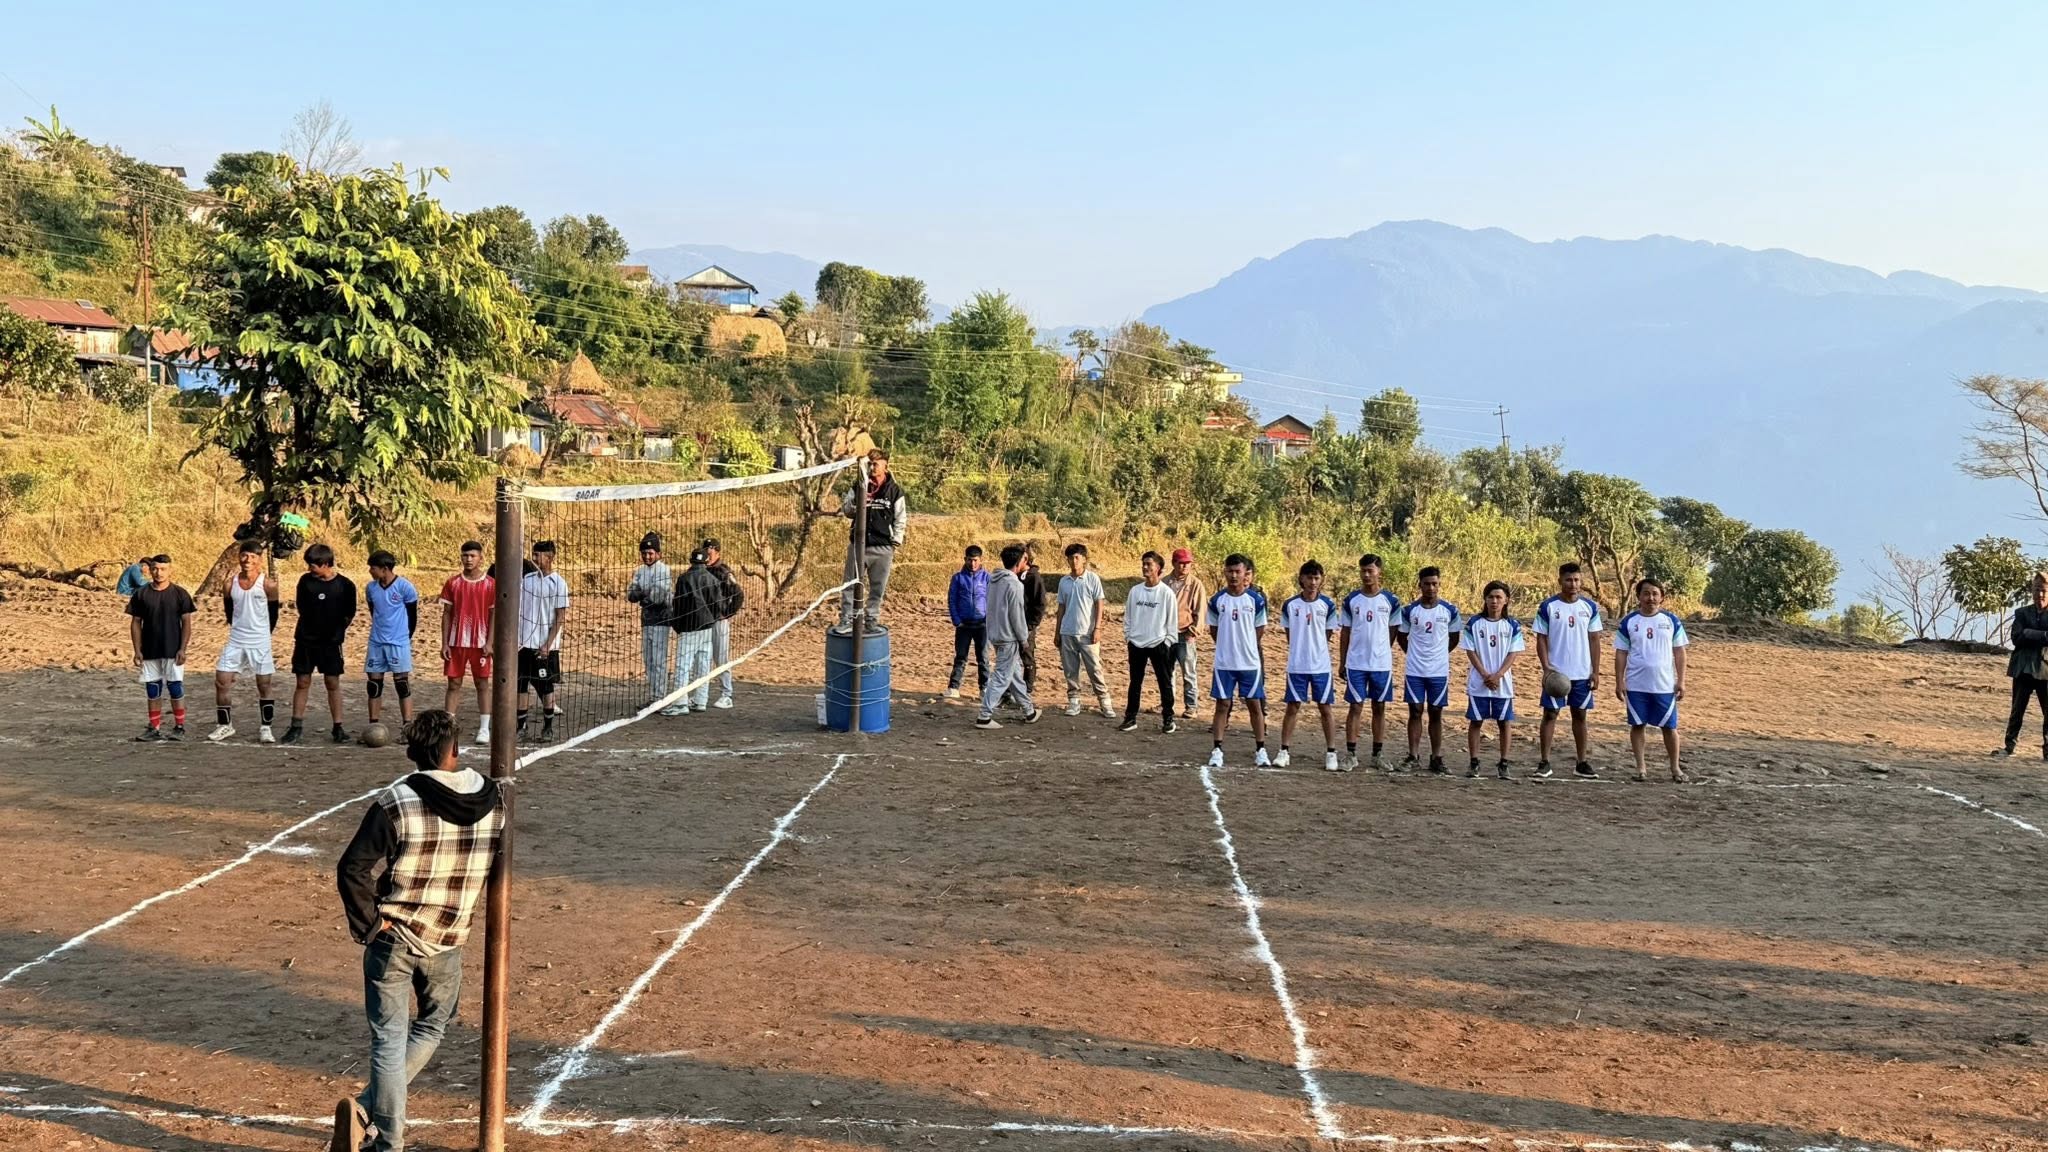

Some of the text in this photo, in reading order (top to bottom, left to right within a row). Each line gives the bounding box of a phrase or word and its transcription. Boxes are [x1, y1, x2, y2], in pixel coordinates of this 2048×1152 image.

[575, 489, 600, 501] SAGAR
[1231, 608, 1238, 621] 5
[1306, 613, 1312, 625] 1
[1366, 610, 1373, 622] 6
[1425, 621, 1433, 633] 2
[1568, 615, 1575, 628] 9
[1646, 627, 1654, 639] 8
[1489, 634, 1497, 647] 3
[480, 657, 487, 667] 9
[538, 668, 547, 678] 8
